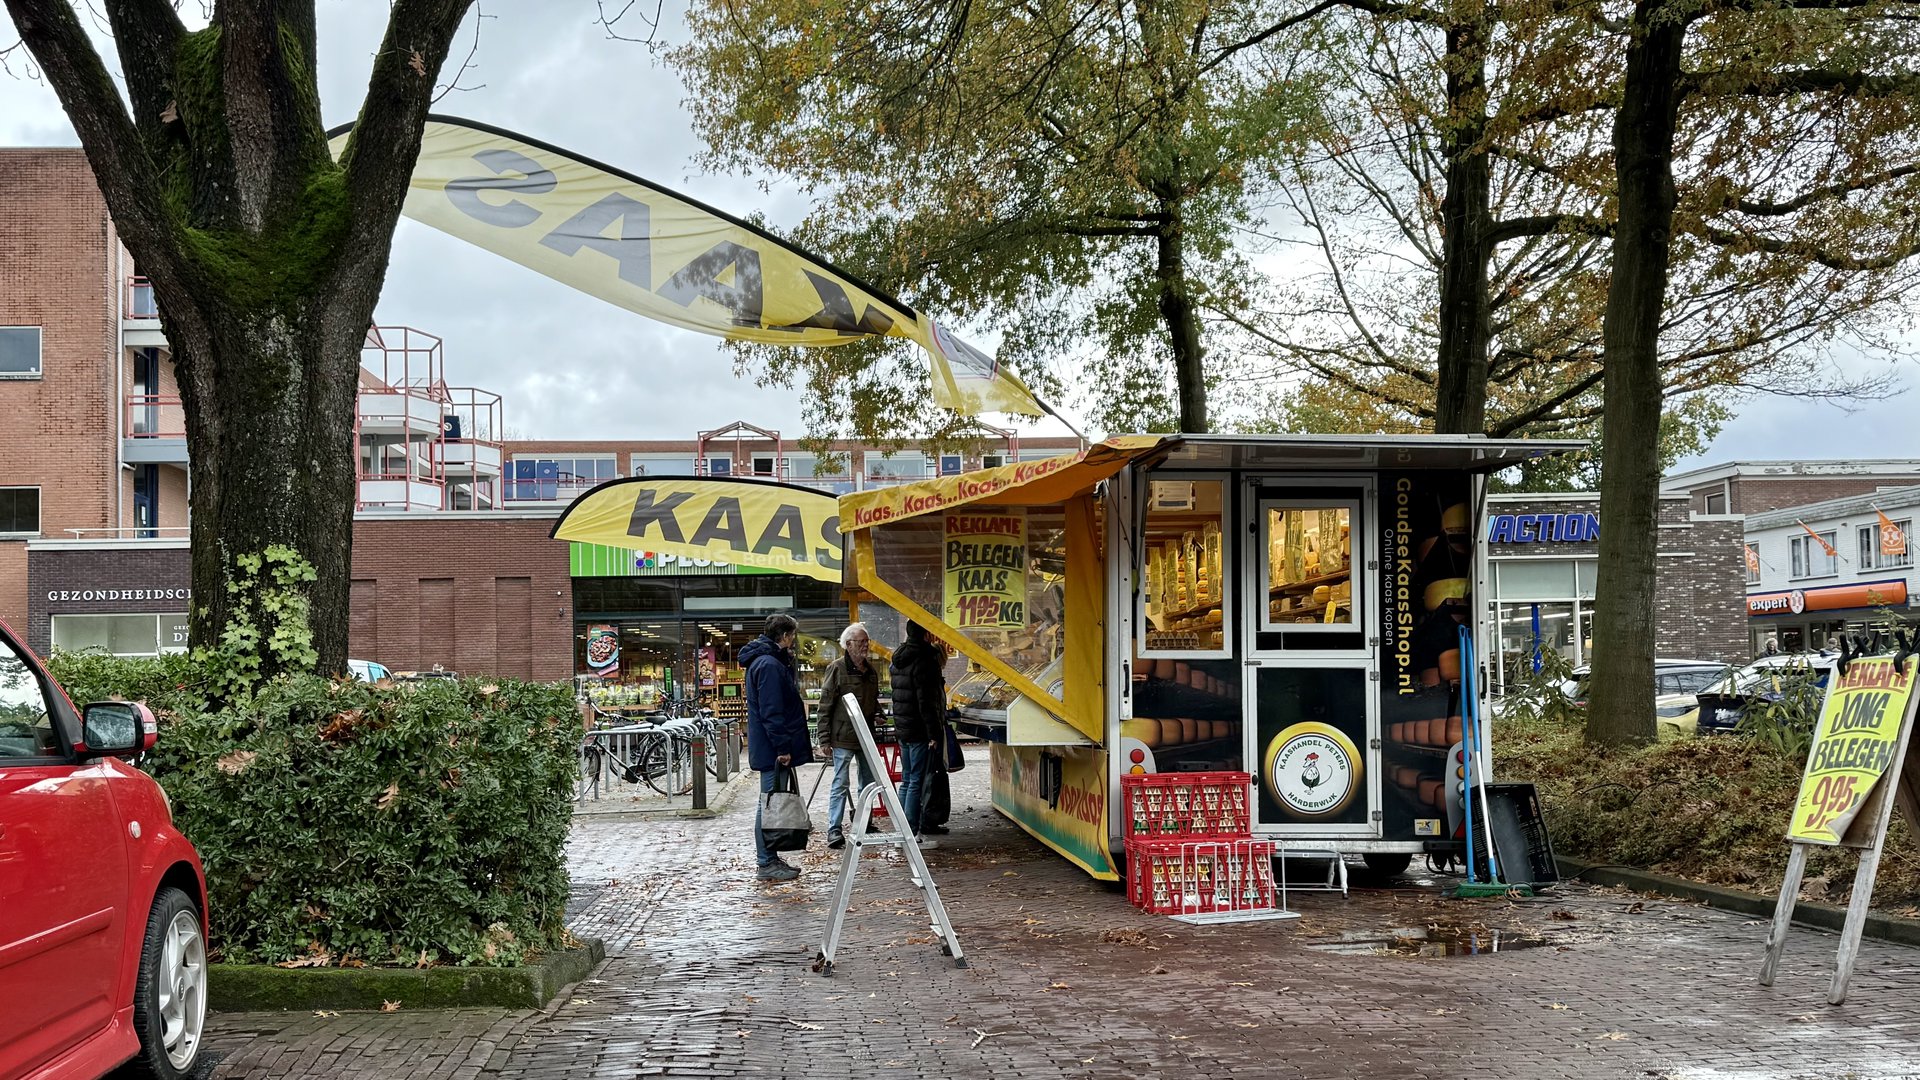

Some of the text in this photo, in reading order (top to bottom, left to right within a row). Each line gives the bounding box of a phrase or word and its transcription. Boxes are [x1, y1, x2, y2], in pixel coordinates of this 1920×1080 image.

[626, 488, 843, 570] KAAS
[946, 516, 1022, 534] REKLAME
[1489, 513, 1600, 542] ACTION
[659, 549, 731, 567] PLUS
[946, 540, 1025, 569] BELEGEN
[958, 570, 1009, 592] KAAS
[1383, 529, 1395, 646] Online kaas kopen
[1395, 478, 1415, 695] GoudseKaasShop.nl
[1750, 597, 1788, 610] expert
[1830, 692, 1892, 734] JONG
[1279, 740, 1346, 770] KAASHANDEL PETERS
[1810, 738, 1896, 773] BELEGEN
[1287, 792, 1338, 808] HARDERWIJK
